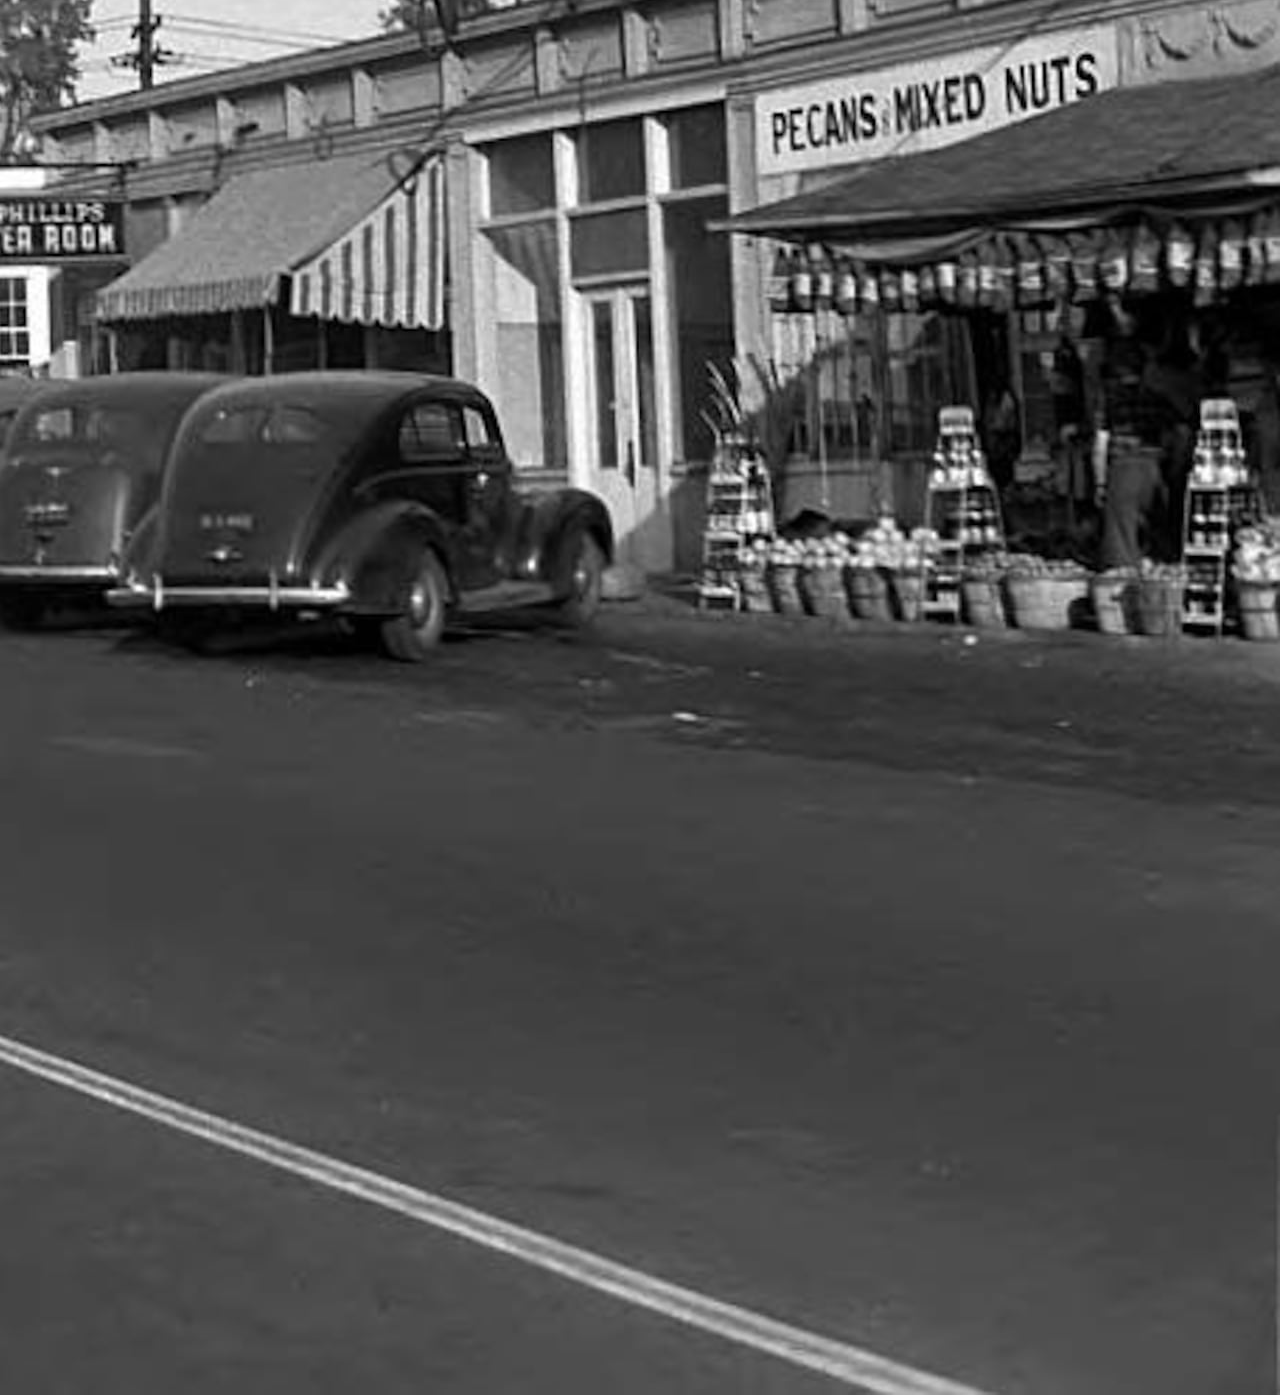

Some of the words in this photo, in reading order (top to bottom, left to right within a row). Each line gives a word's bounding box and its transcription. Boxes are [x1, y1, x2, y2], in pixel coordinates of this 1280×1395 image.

[771, 93, 878, 155] PECANS
[893, 73, 987, 134] MIXED
[1004, 52, 1099, 114] NUTS
[44, 223, 116, 254] ROOM
